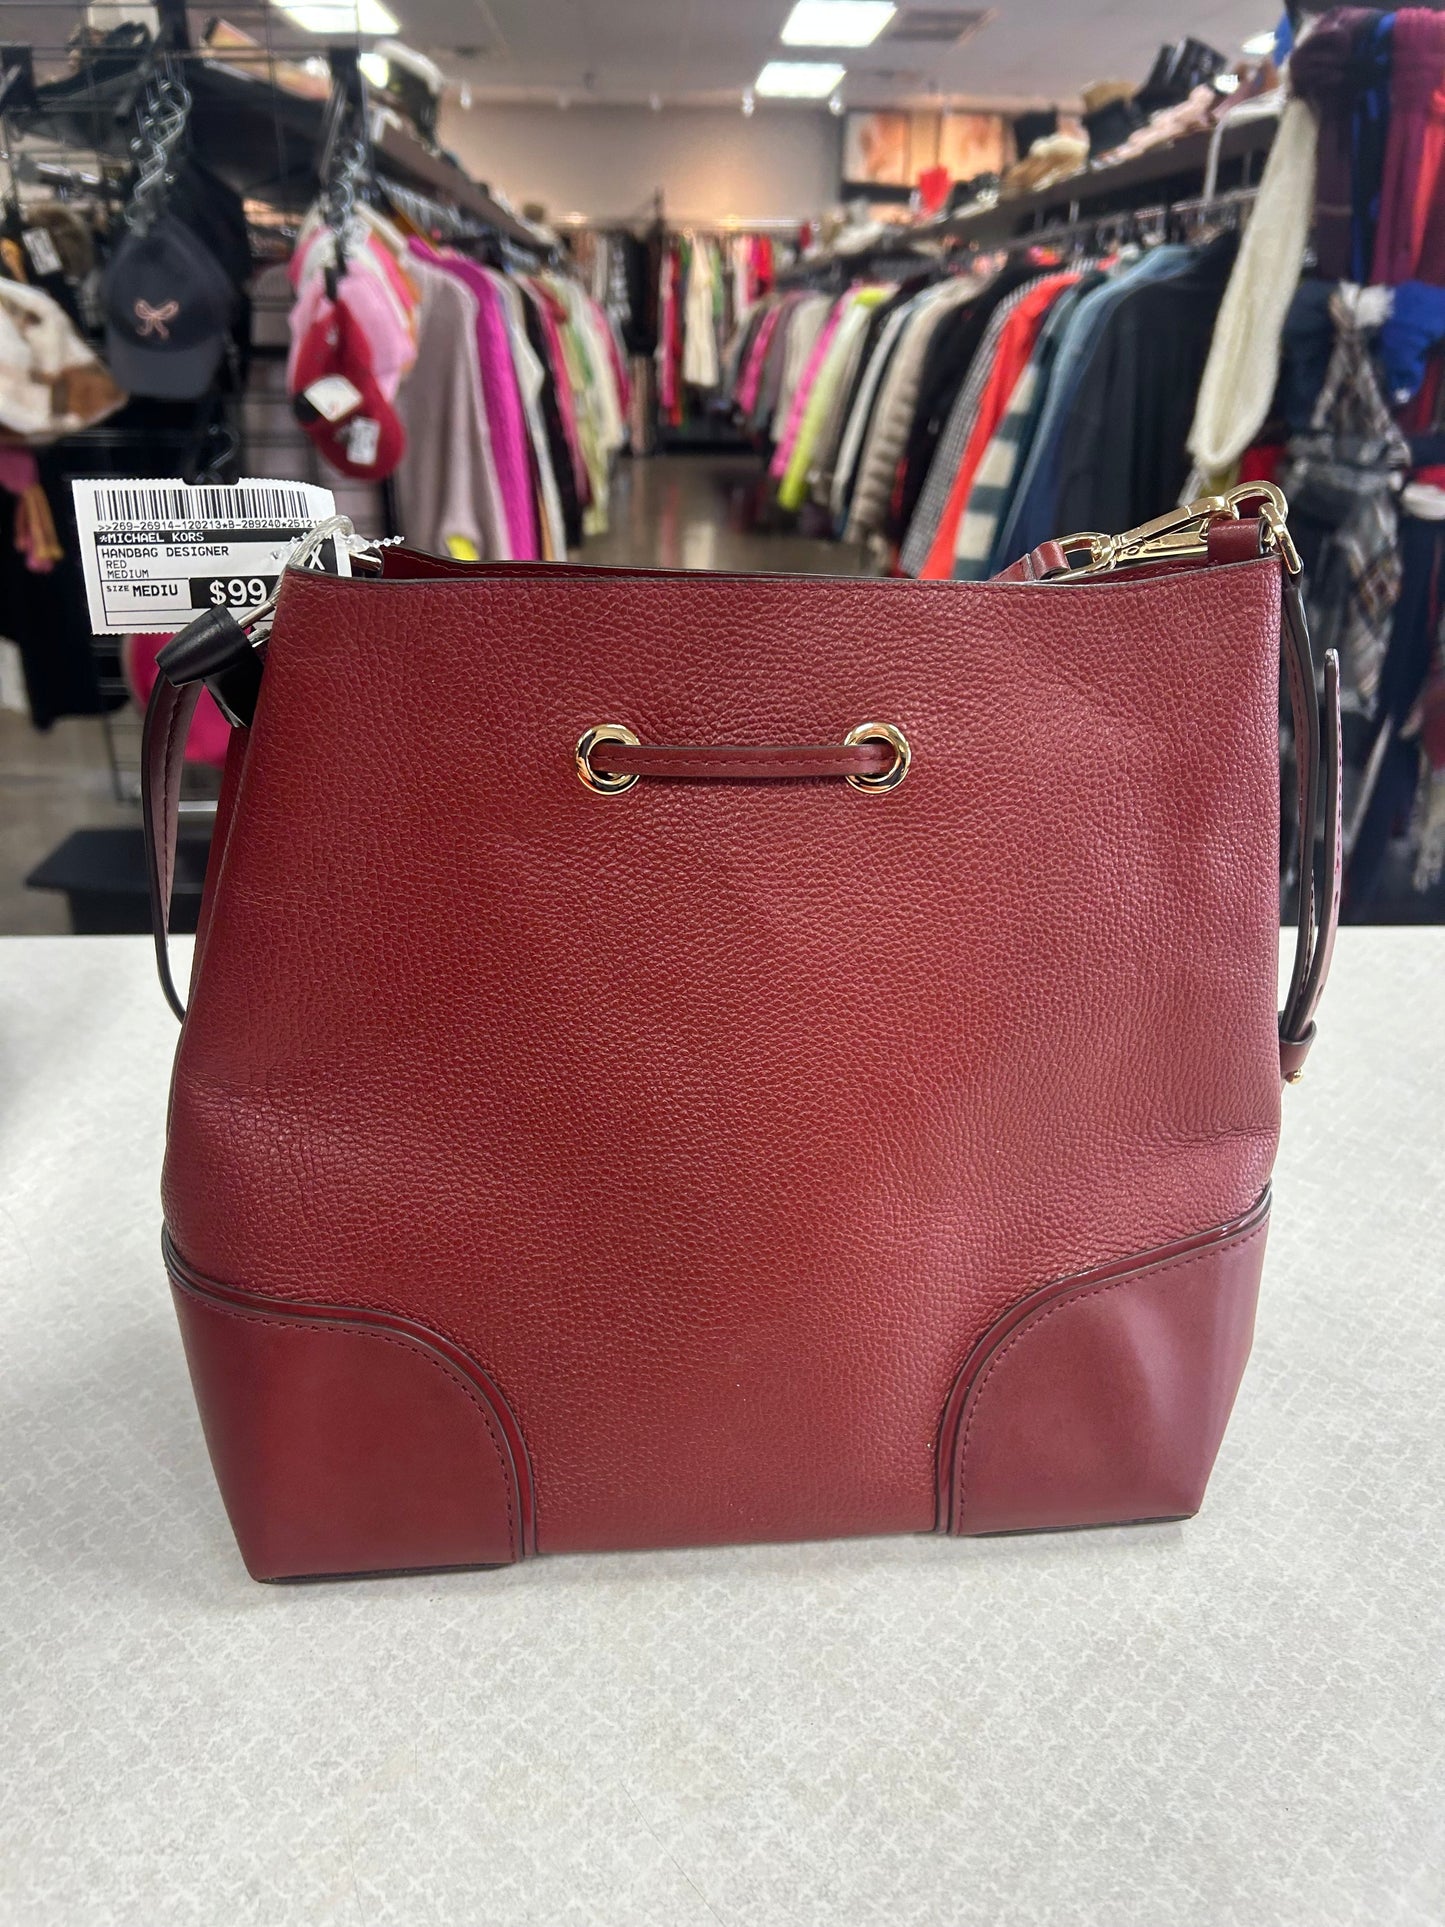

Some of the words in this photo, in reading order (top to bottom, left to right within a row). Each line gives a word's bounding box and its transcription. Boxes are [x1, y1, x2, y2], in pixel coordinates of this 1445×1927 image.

[172, 531, 204, 543] KORS
[102, 546, 159, 559] HANDBAG
[166, 545, 229, 558] DESIGNER
[106, 559, 127, 569] RED
[107, 569, 149, 579] MEDIUM
[133, 584, 178, 597] MEDIU
[209, 579, 268, 605] $99
